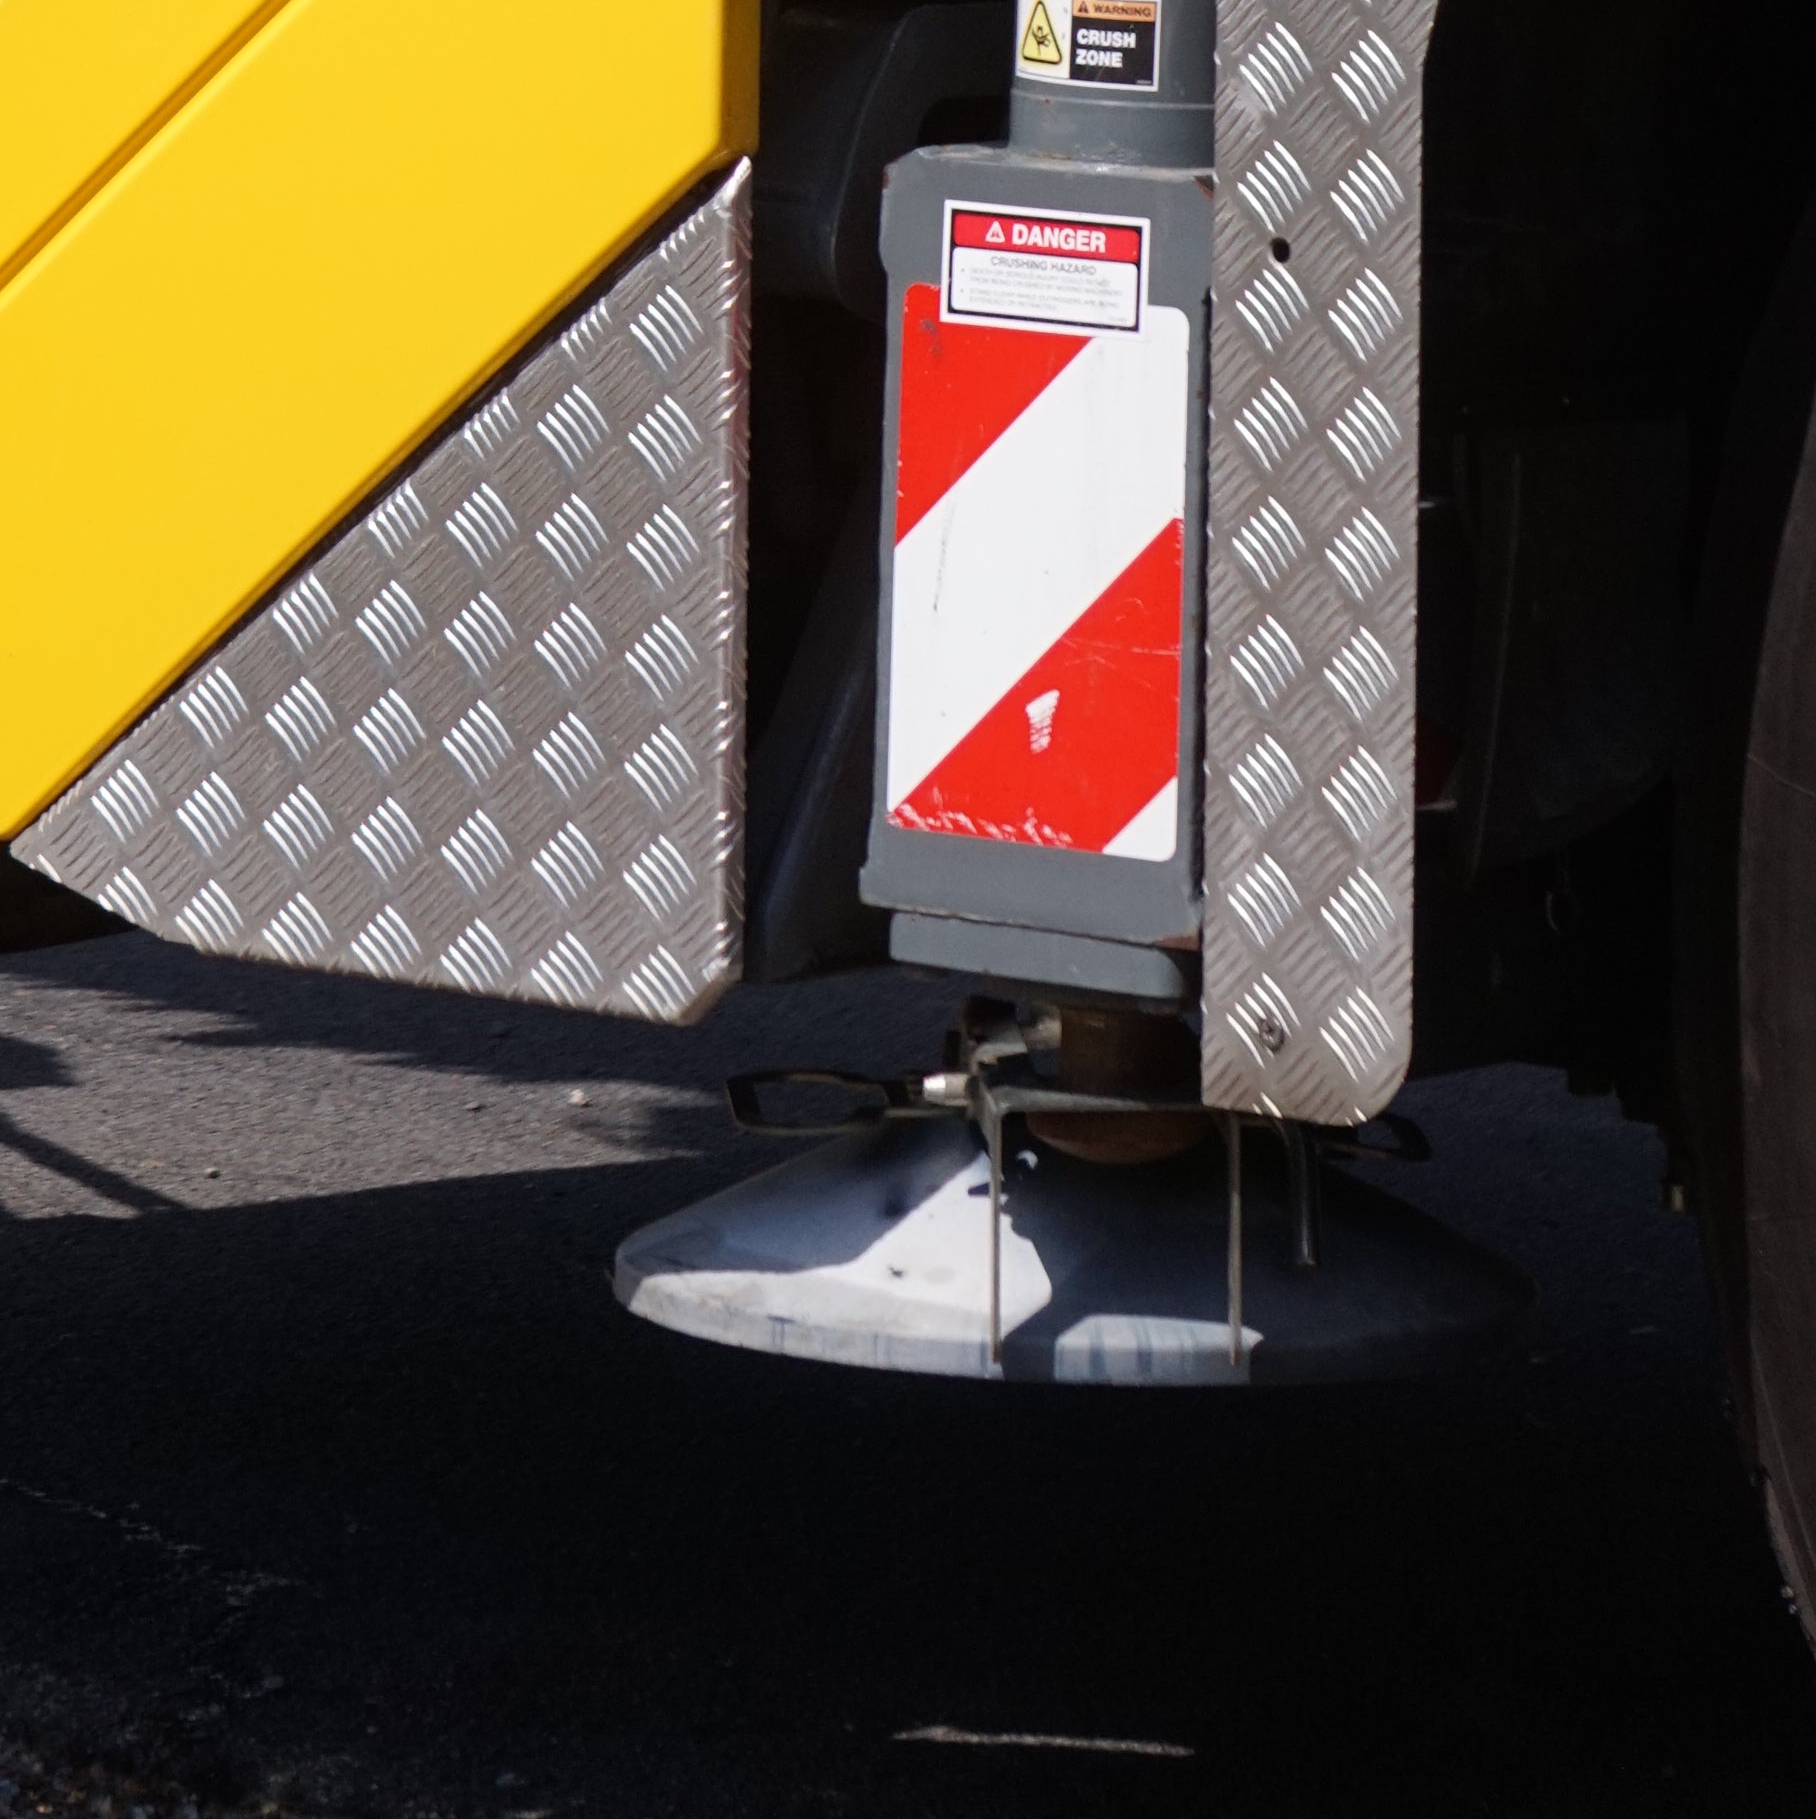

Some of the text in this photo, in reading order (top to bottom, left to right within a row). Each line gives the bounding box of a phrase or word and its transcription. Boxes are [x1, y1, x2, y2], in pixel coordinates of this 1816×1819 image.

[1093, 4, 1153, 17] WARNING
[1076, 28, 1137, 49] CRUSH
[1074, 48, 1123, 69] ZONE
[1012, 223, 1107, 254] DANGER
[990, 255, 1097, 276] CRUSHING HAZARD
